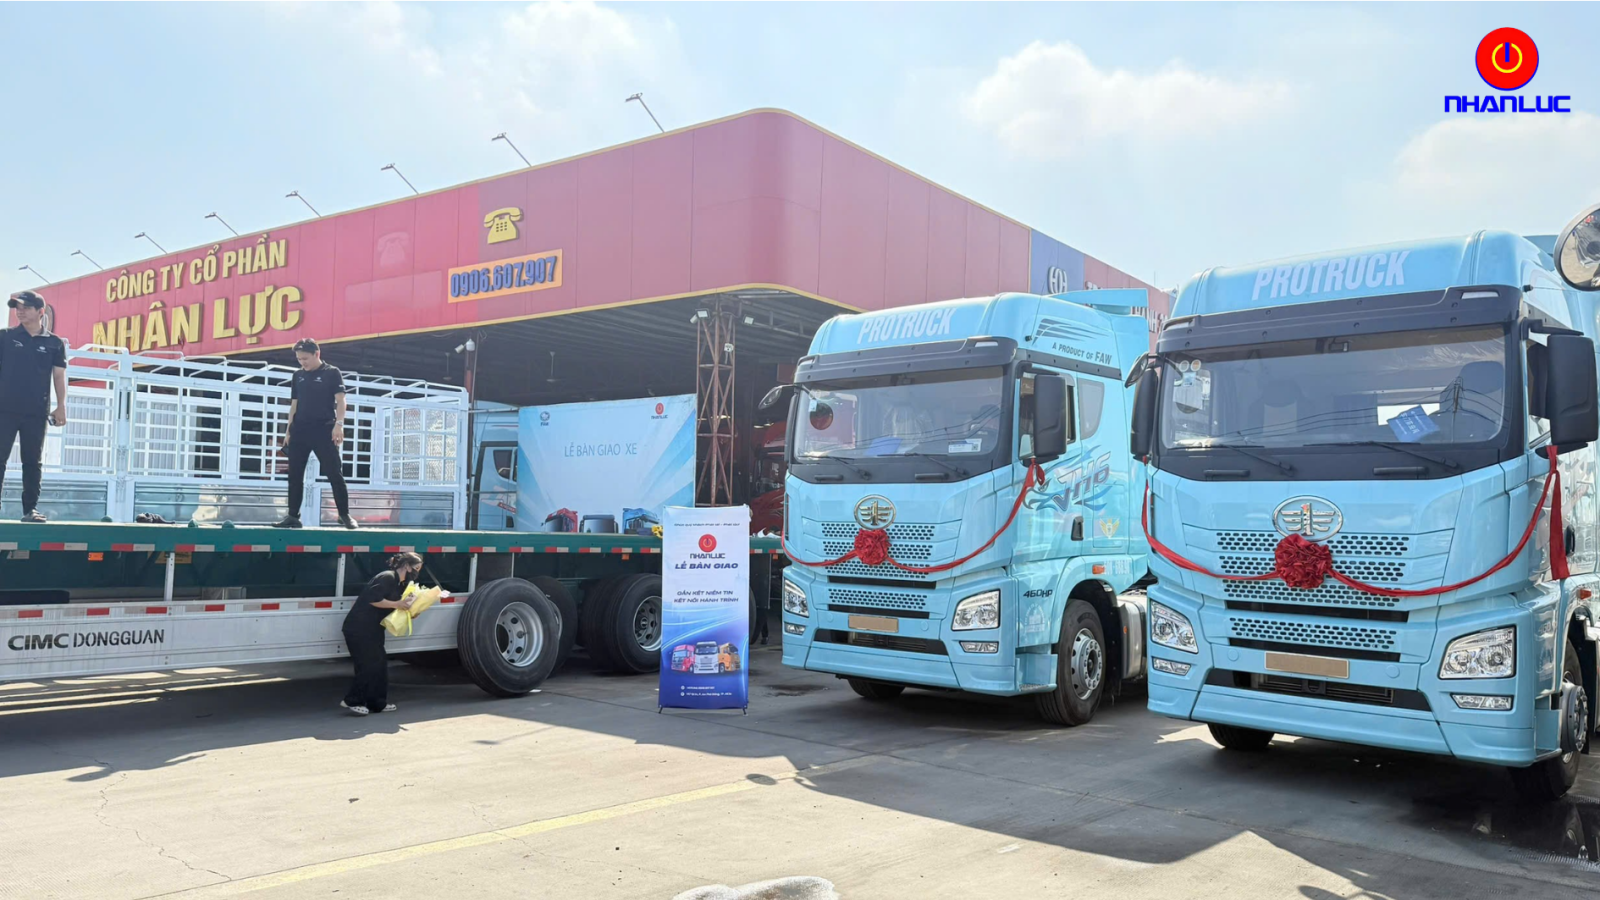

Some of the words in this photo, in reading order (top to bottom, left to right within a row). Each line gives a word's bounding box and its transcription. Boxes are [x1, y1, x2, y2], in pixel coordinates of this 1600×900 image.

[106, 269, 155, 303] CÔNG
[160, 262, 184, 291] TY
[189, 244, 219, 285] CỔ
[222, 233, 288, 278] PHẦN
[450, 256, 557, 298] 0906.607.907
[1252, 250, 1410, 301] PROTRUCK
[93, 301, 202, 354] NHÂN
[213, 285, 303, 344] LỰC
[857, 307, 957, 344] PROTRUCK
[1059, 344, 1085, 357] PRODUCT
[1095, 351, 1112, 364] FAW
[576, 442, 595, 457] BÀN
[597, 443, 621, 457] GIAO
[625, 442, 637, 455] XE
[8, 633, 69, 651] CIMC
[73, 629, 165, 648] DONGGUAN
